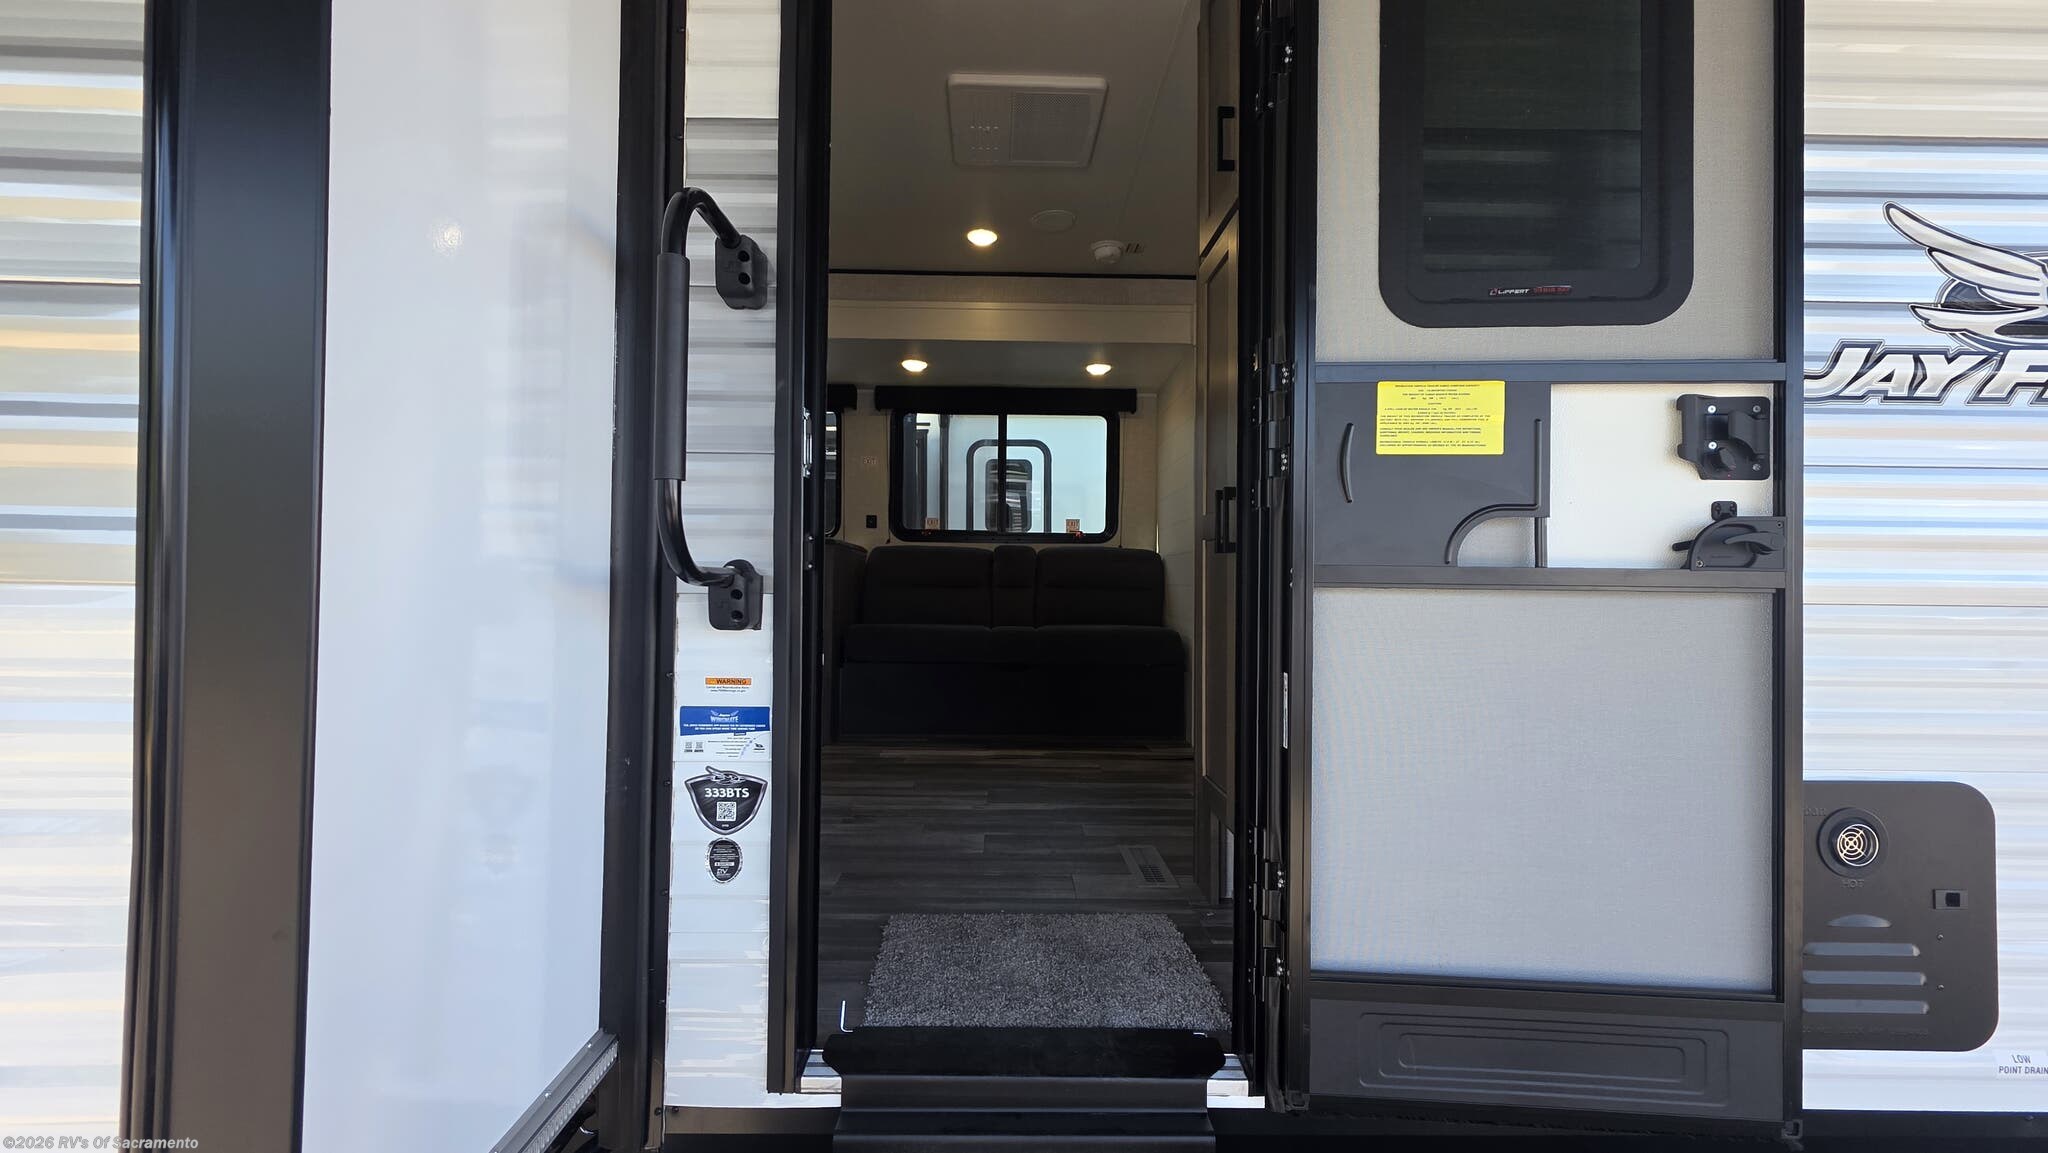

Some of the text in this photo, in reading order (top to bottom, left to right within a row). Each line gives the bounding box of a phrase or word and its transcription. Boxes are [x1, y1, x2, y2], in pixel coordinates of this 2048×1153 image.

[1804, 342, 2048, 403] JAY F
[704, 787, 750, 798] 333BTS
[2011, 1054, 2031, 1063] LOW
[1999, 1065, 2022, 1074] POINT
